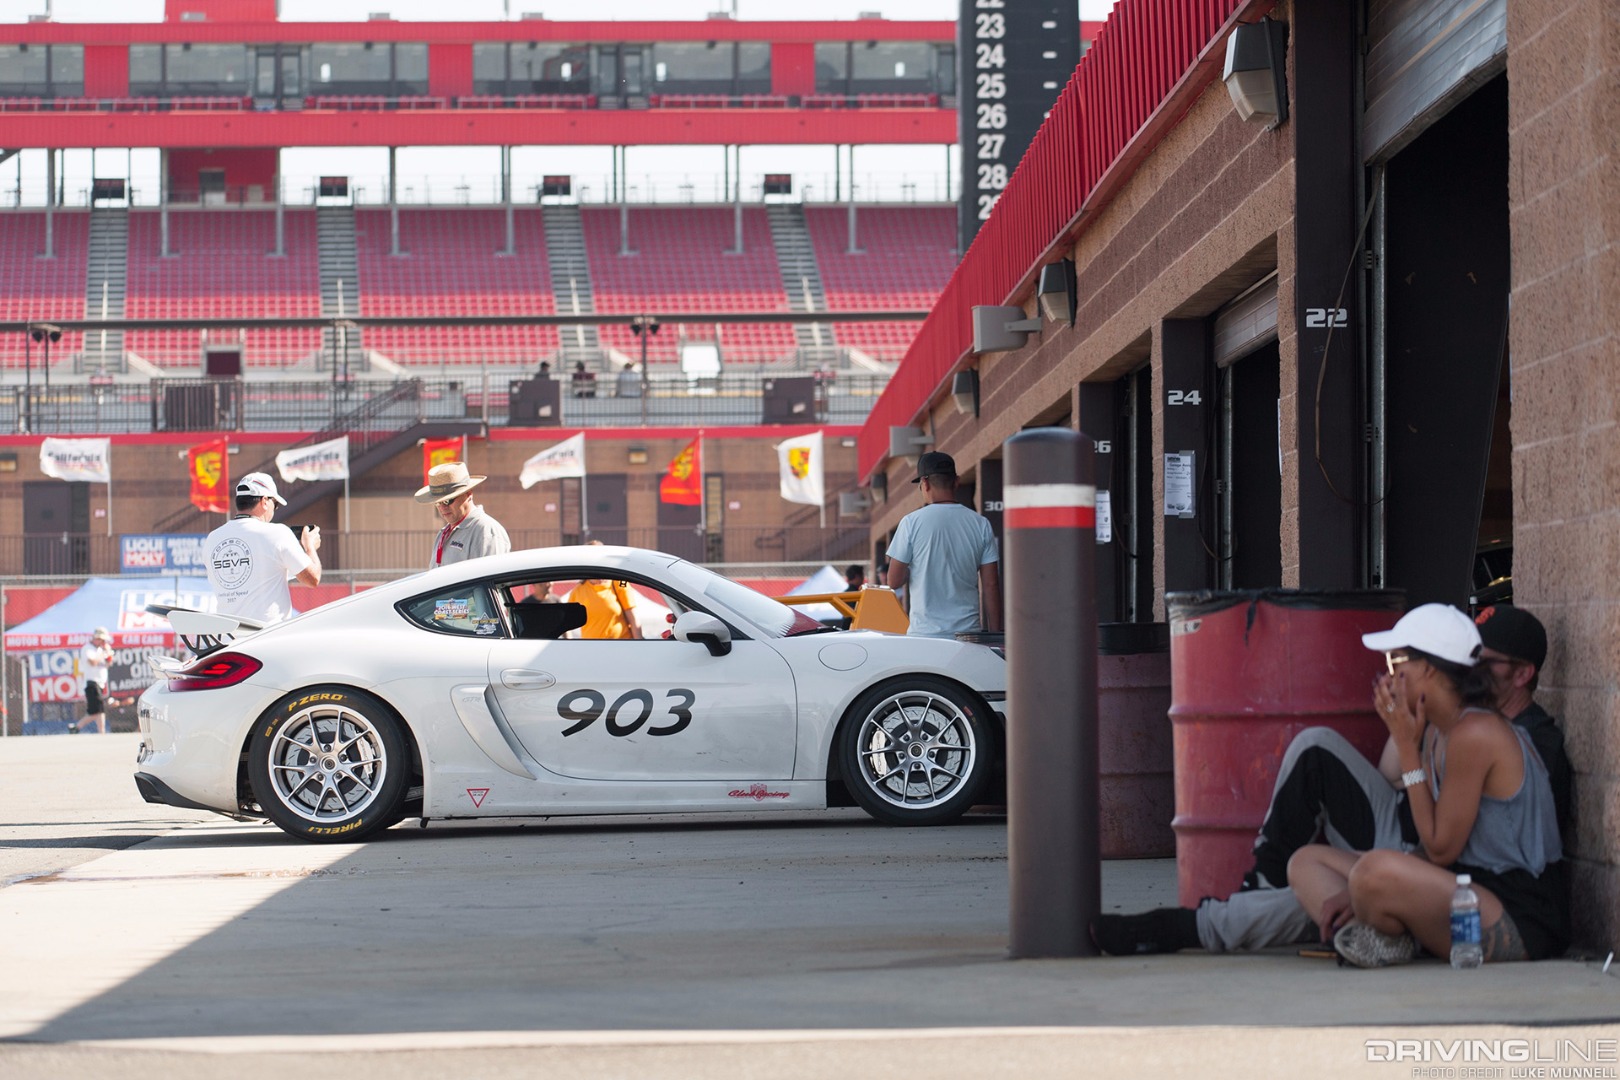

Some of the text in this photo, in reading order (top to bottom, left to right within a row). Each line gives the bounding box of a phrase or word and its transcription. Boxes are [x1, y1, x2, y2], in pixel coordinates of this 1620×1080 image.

[976, 13, 1006, 38] 23
[976, 43, 1006, 69] 24
[976, 73, 1007, 99] 25
[977, 103, 1008, 129] 26
[977, 134, 1006, 159] 27
[977, 164, 1008, 190] 28
[1305, 308, 1348, 328] 22
[1167, 390, 1202, 405] 24
[984, 501, 1004, 512] 30
[126, 538, 163, 551] LIQUI
[125, 552, 165, 567] MOLY
[213, 558, 250, 569] SGVR
[7, 634, 61, 647] MOTOR OILS
[122, 633, 140, 645] CAR
[288, 692, 344, 712] P ZERO
[557, 688, 696, 737] 903
[308, 818, 364, 835] PIRELLI
